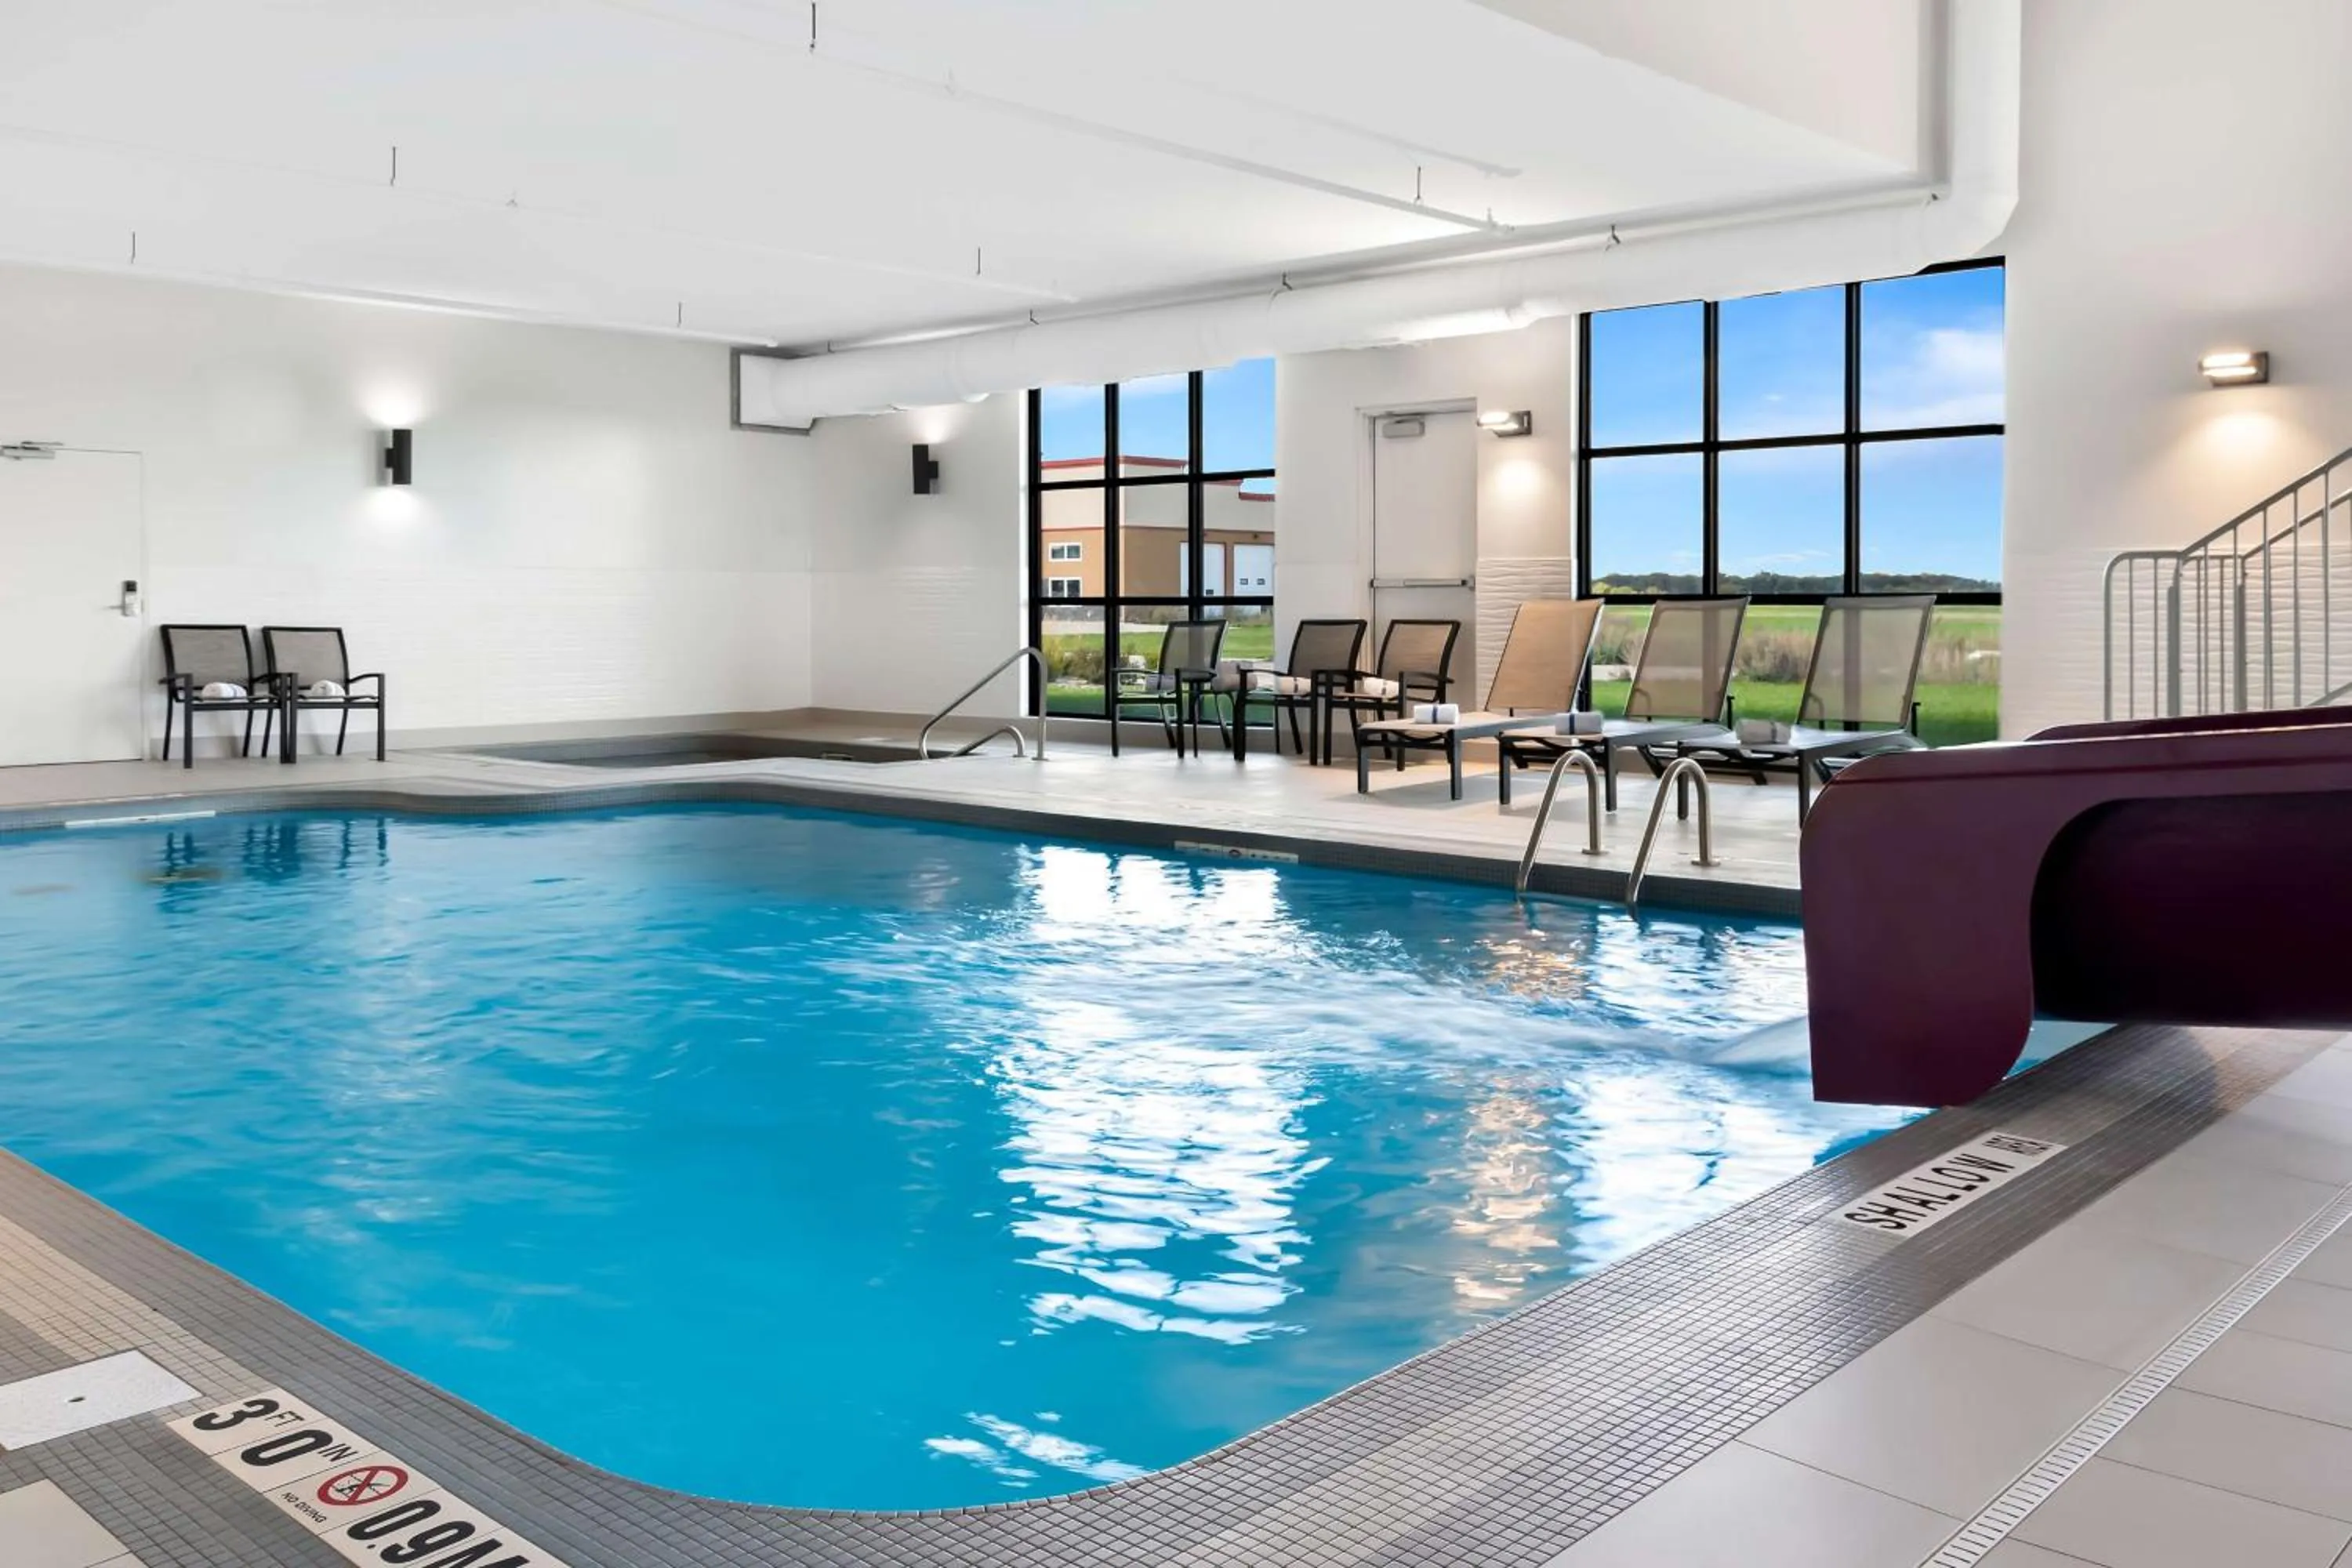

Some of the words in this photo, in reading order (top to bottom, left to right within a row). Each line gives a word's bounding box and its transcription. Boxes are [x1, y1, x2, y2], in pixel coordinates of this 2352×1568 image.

[1844, 1153, 2016, 1230] SHALLOW
[281, 1492, 299, 1503] NO
[294, 1501, 327, 1523] DIVING
